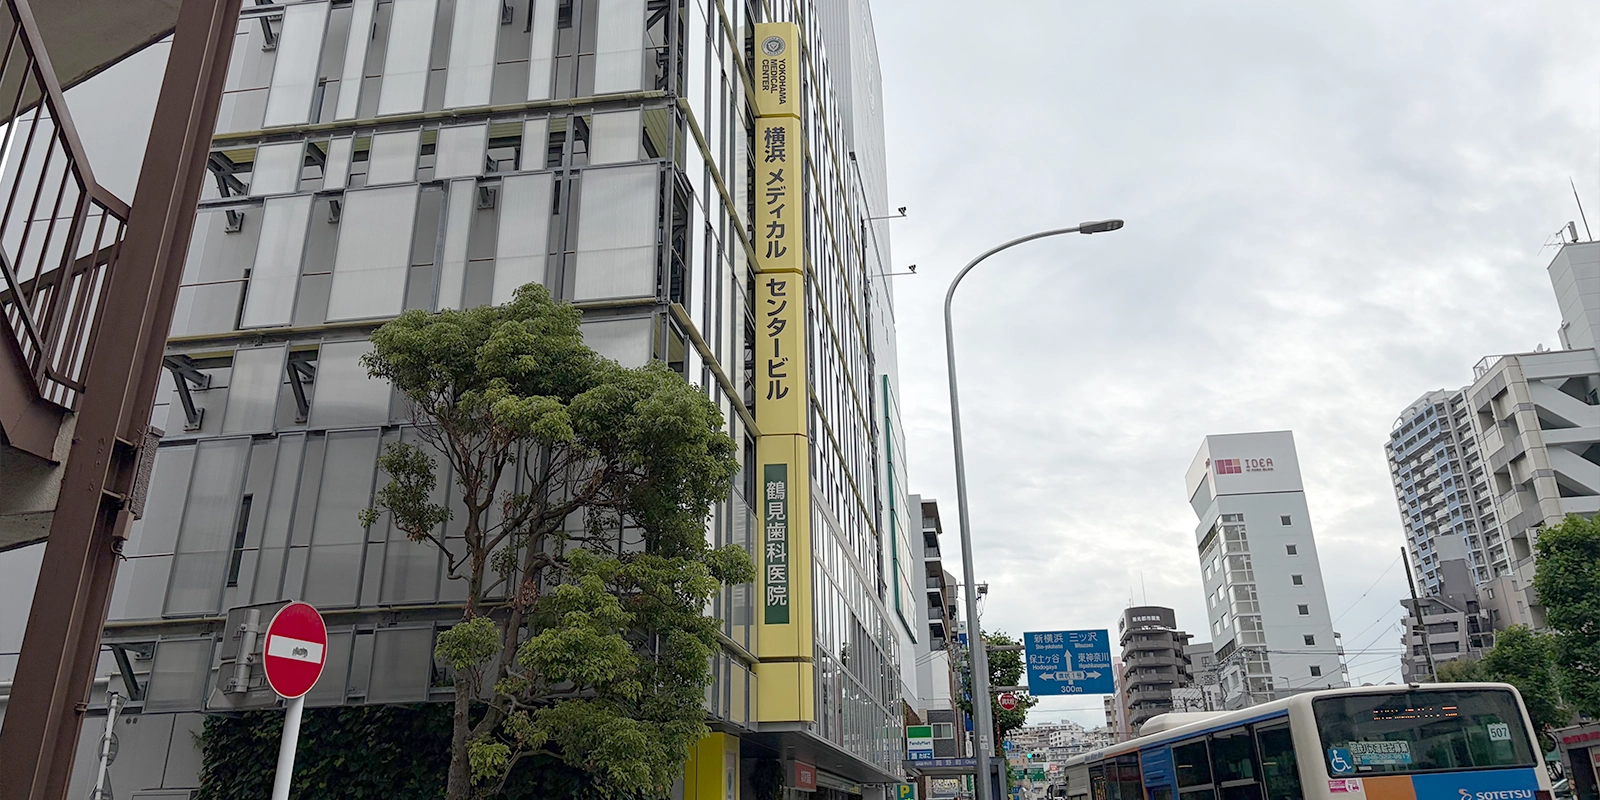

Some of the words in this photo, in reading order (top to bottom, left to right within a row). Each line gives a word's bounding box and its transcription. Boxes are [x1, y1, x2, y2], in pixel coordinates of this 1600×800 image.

[762, 59, 770, 91] CENTER
[770, 58, 778, 94] MEDICAL
[778, 58, 787, 105] YOKOHAMA
[763, 126, 787, 163] 横浜
[766, 168, 787, 260] メディカル
[765, 277, 790, 402] センタービル
[1244, 458, 1275, 468] IDEA
[766, 480, 788, 607] 鶴見歯科医院
[1033, 633, 1064, 643] 新横浜
[1069, 631, 1098, 642] 三ツ沢
[1077, 652, 1110, 662] 東神奈川
[1060, 685, 1083, 693] 300m
[1490, 727, 1508, 738] 507
[900, 785, 910, 798] P
[1475, 789, 1532, 800] SOTETSU
